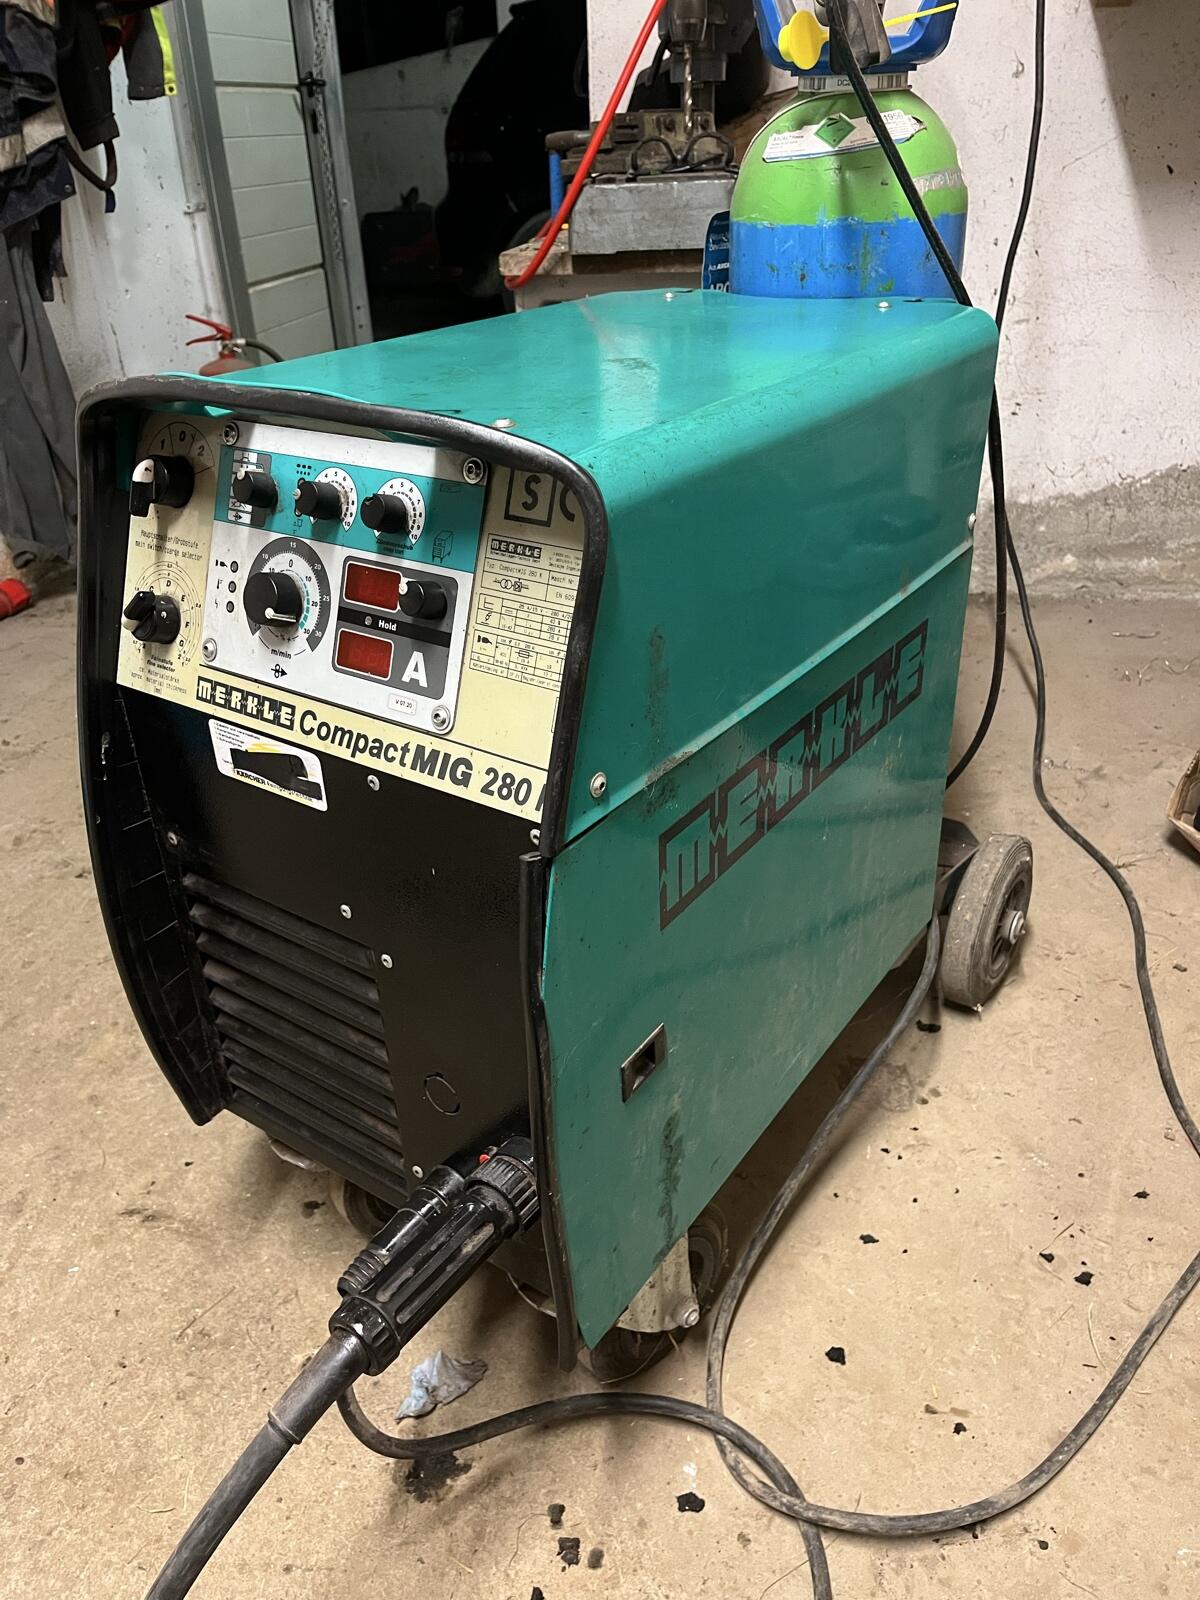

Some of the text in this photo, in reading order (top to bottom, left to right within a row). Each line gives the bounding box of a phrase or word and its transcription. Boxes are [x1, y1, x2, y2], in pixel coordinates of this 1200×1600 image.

[179, 430, 187, 442] 0
[159, 438, 166, 450] 1
[198, 445, 205, 457] 2
[521, 474, 542, 512] S
[289, 541, 297, 549] 15
[490, 538, 543, 560] MERKLE
[288, 559, 294, 568] 0
[313, 563, 322, 571] 20
[305, 575, 312, 583] 10
[180, 594, 186, 602] E
[311, 600, 319, 608] 20
[322, 595, 331, 603] 25
[184, 621, 190, 629] F
[378, 619, 398, 632] Hold
[270, 647, 293, 660] m/min
[401, 650, 429, 689] A
[196, 675, 296, 731] MERKLE
[299, 709, 473, 789] CompactMIG
[479, 767, 533, 806] 280
[658, 618, 929, 931] MERKLE
